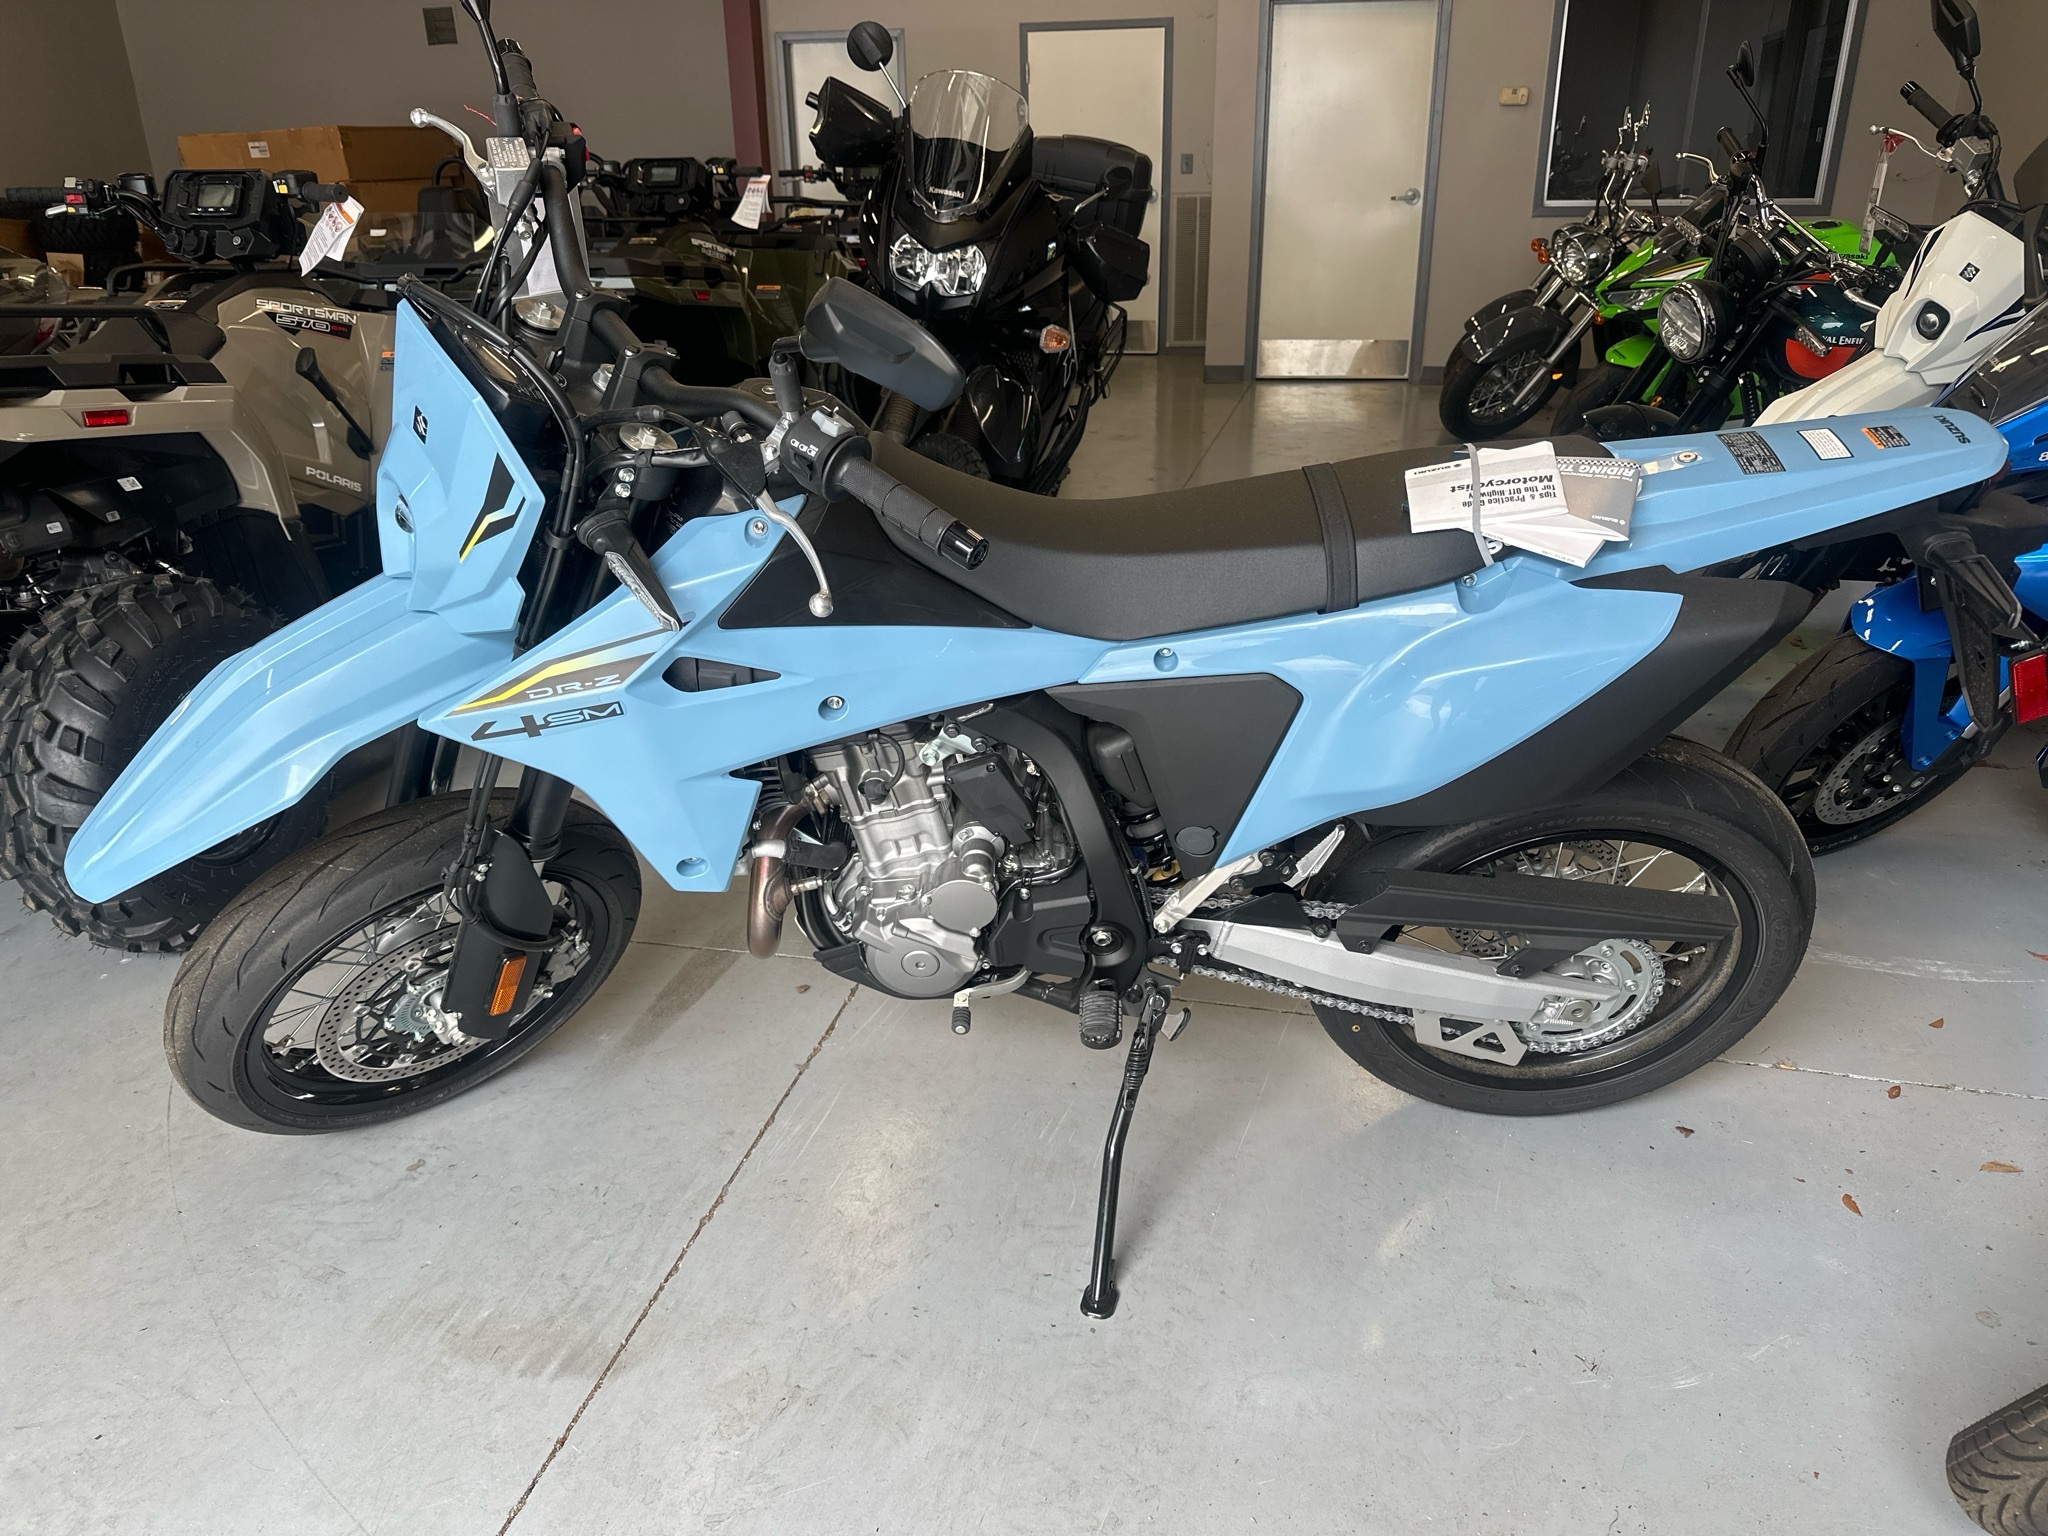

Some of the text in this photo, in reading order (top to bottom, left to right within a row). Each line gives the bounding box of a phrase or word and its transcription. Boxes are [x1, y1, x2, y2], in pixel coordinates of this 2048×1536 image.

[928, 186, 965, 199] Kawasaki
[691, 238, 737, 257] SPORTSMAN
[256, 298, 357, 324] SPORTSMAN
[275, 313, 331, 332] 570
[1933, 415, 1971, 444] SUZUKI
[1413, 465, 1451, 475] SUZUKI
[1578, 464, 1636, 477] RIDING
[306, 466, 362, 492] POLARIS
[1468, 487, 1522, 500] Off-Highwy
[1524, 485, 1539, 493] the
[1539, 491, 1557, 499] Tips
[1462, 499, 1485, 508] Gde
[1488, 494, 1526, 505] Practice
[525, 674, 622, 699] DR-Z
